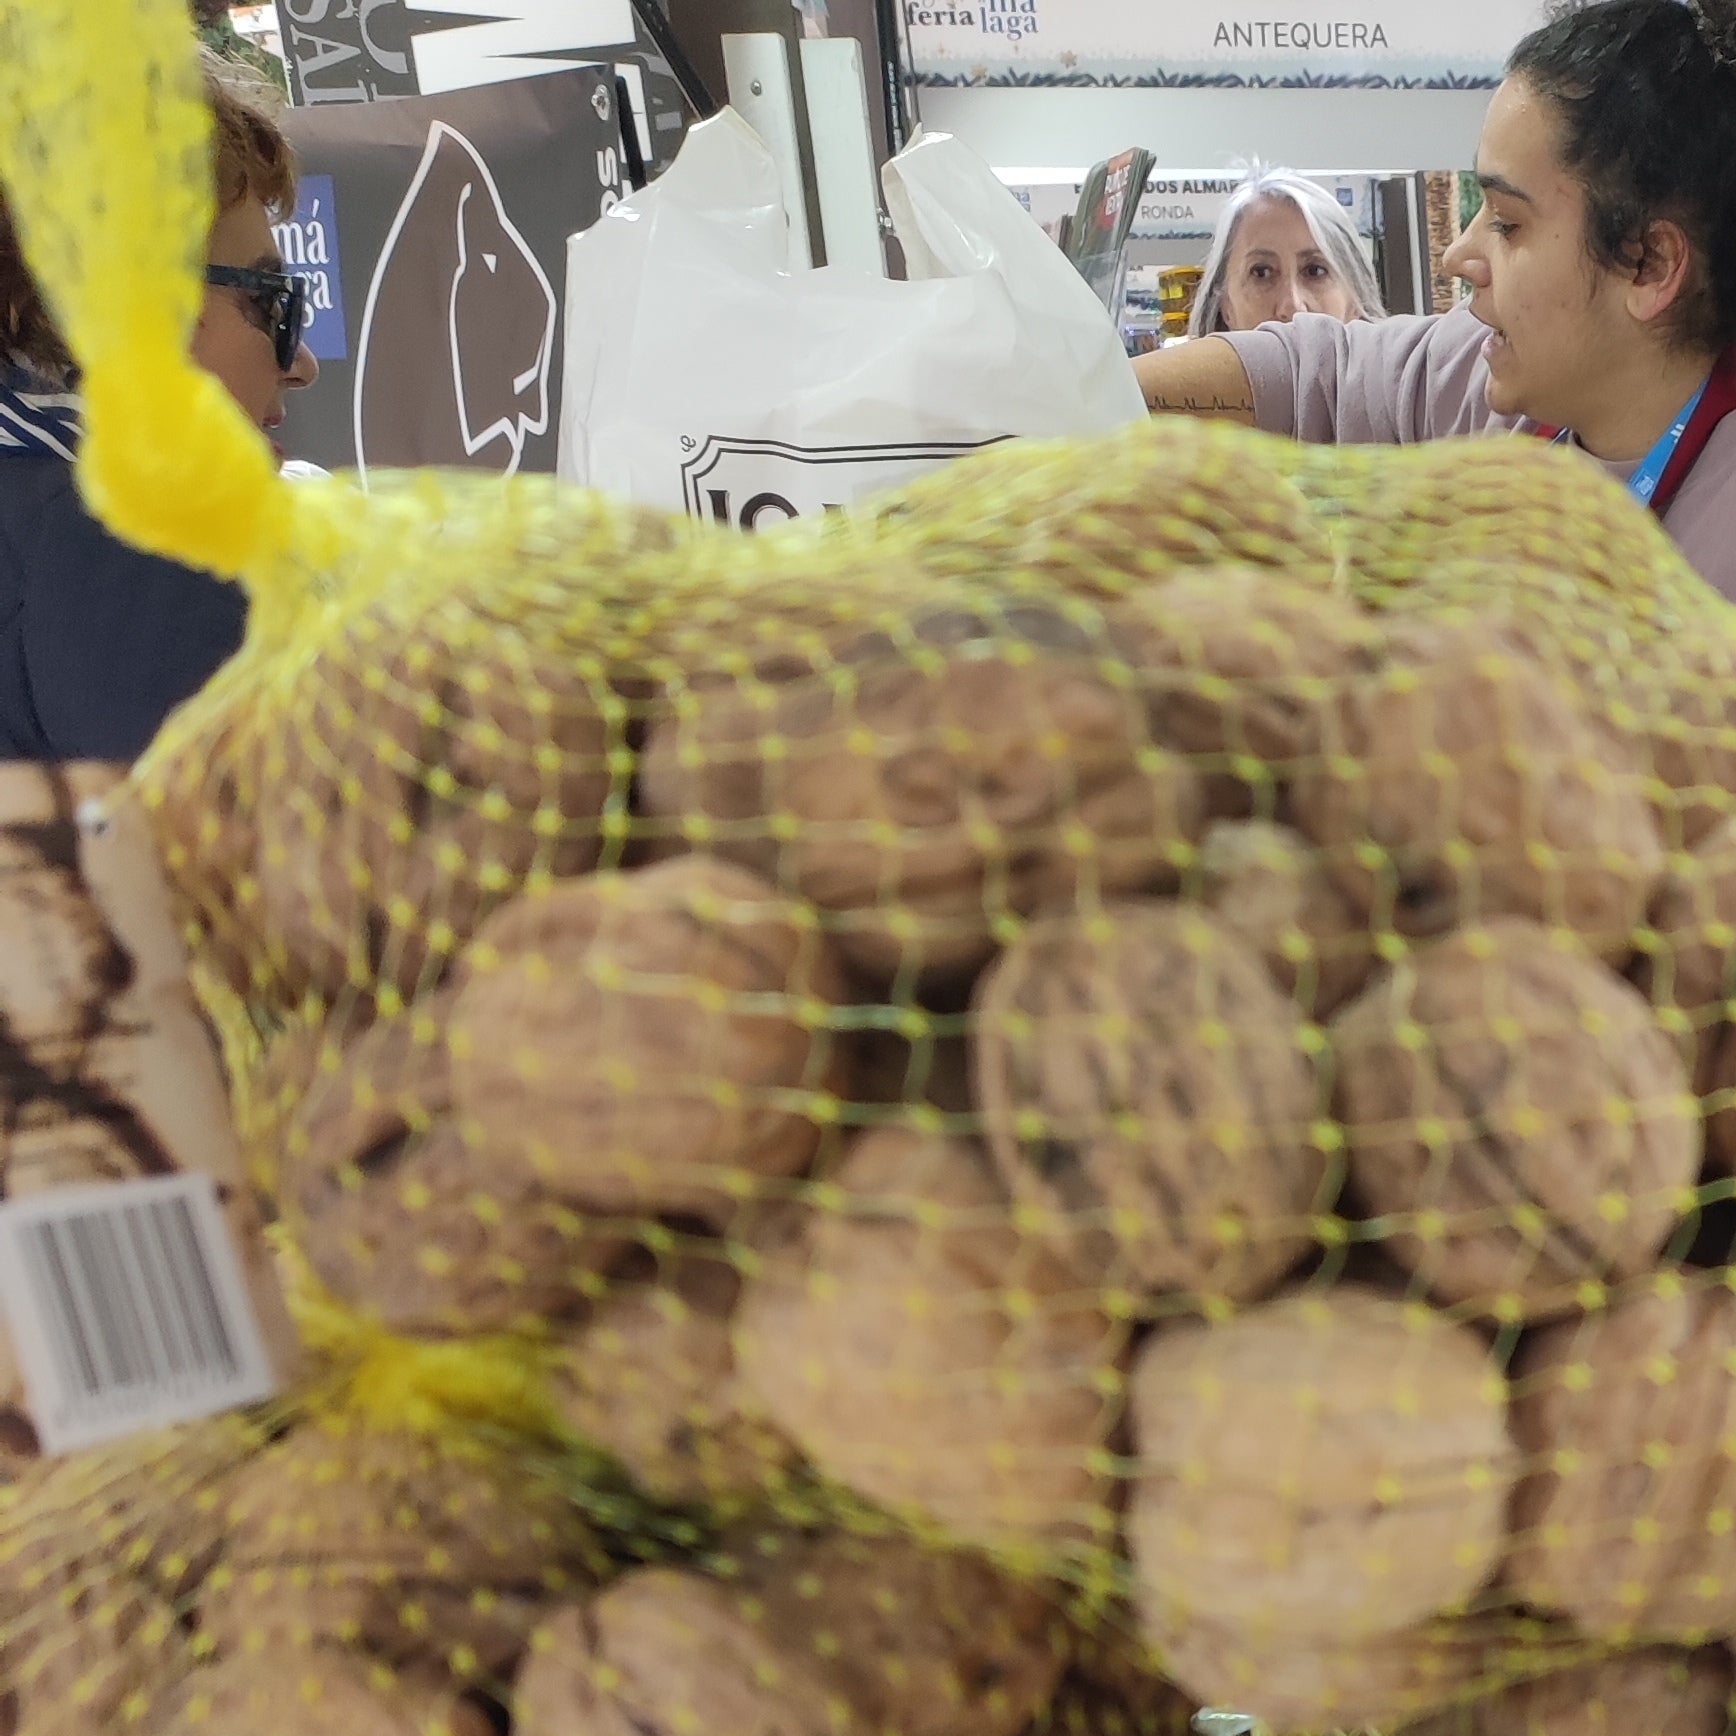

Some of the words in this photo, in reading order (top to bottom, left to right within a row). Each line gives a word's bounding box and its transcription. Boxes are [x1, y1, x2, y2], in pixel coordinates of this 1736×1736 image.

[980, 7, 1038, 41] laga
[1213, 22, 1388, 49] ANTEQUERA
[1141, 206, 1194, 220] RONDA
